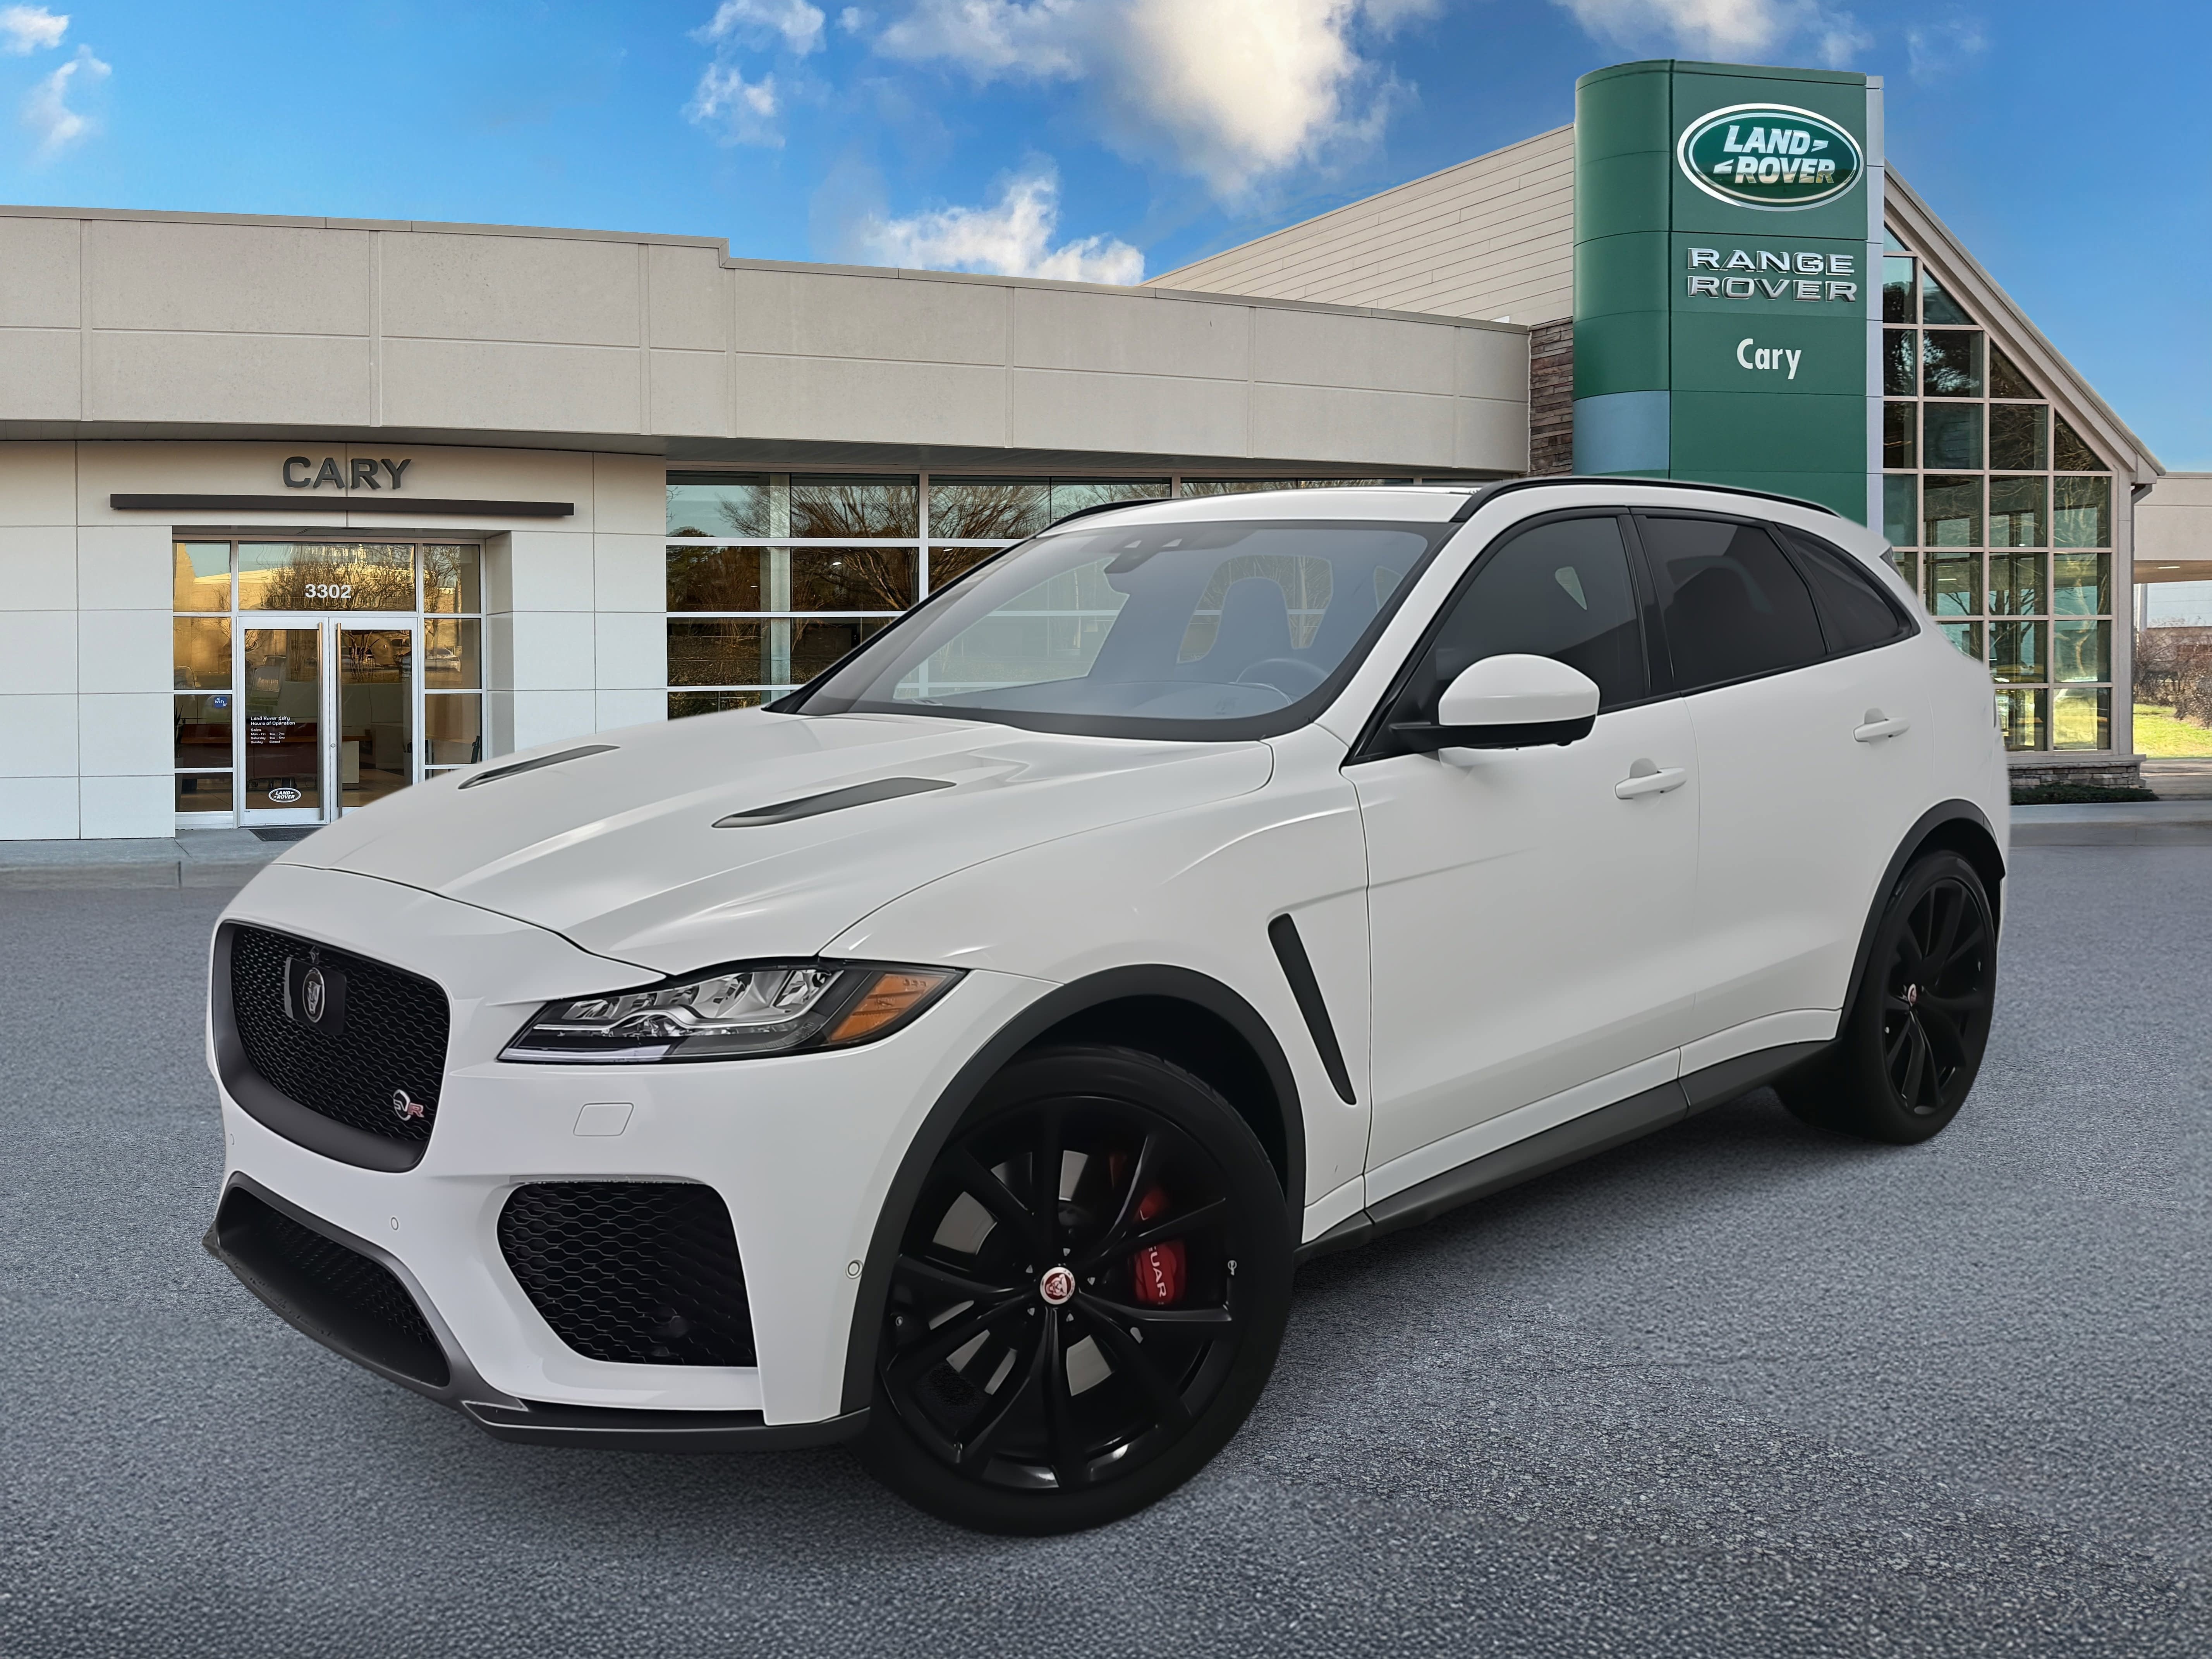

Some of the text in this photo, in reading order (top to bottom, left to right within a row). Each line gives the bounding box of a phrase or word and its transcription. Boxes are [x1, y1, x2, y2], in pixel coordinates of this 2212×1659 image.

[1723, 125, 1811, 156] LAND
[1734, 156, 1835, 184] ROVER
[1687, 247, 1855, 276] RANGE
[1687, 275, 1858, 303] ROVER
[1736, 338, 1802, 380] Cary
[283, 456, 412, 489] CARY
[305, 584, 352, 599] 3302
